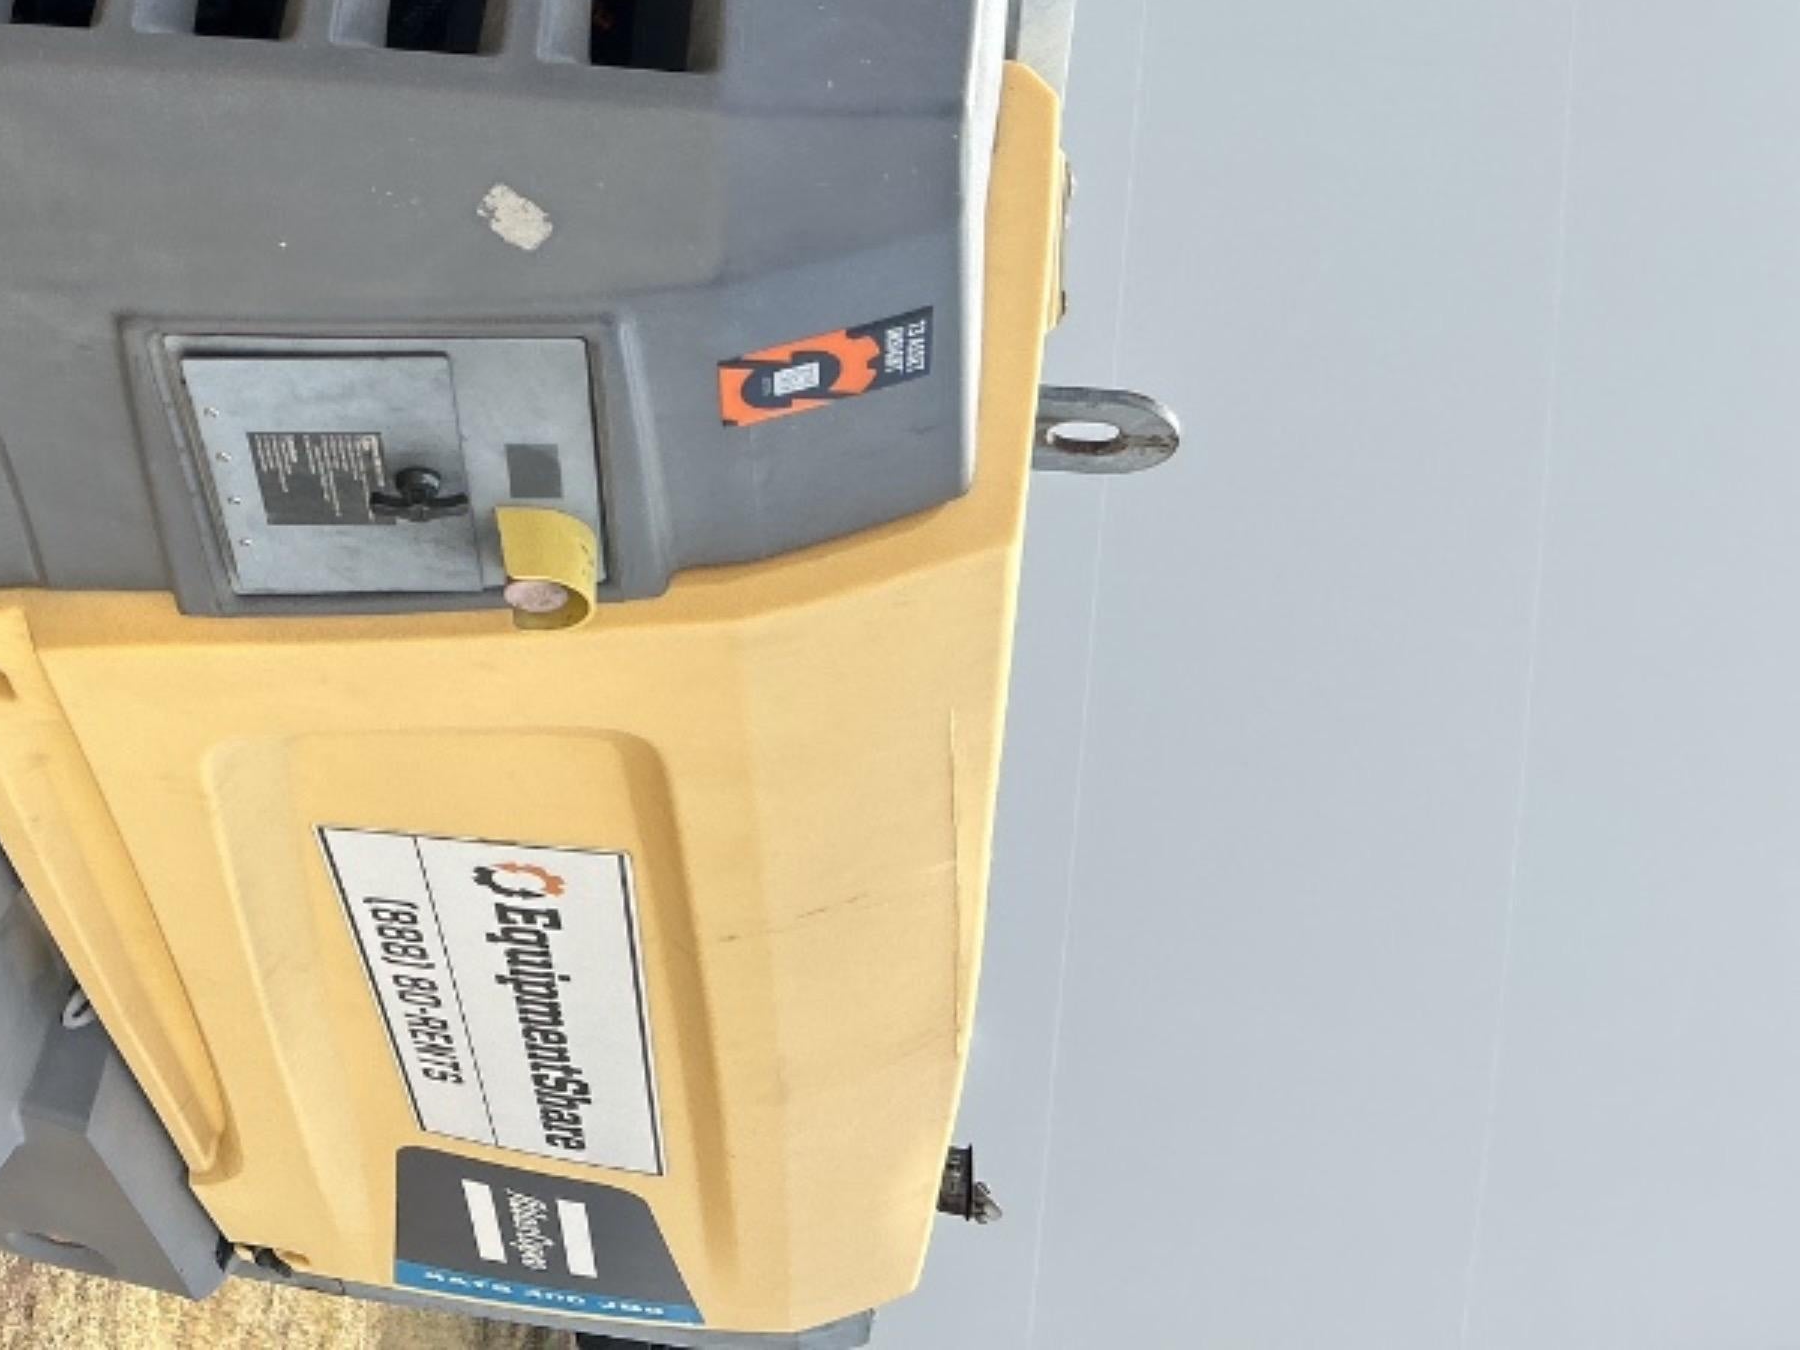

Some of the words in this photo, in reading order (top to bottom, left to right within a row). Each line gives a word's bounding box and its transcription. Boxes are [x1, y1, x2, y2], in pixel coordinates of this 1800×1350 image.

[363, 896, 436, 970] (888)
[392, 973, 467, 1084] 80-RENTS
[485, 902, 592, 1151] EquipmentShare
